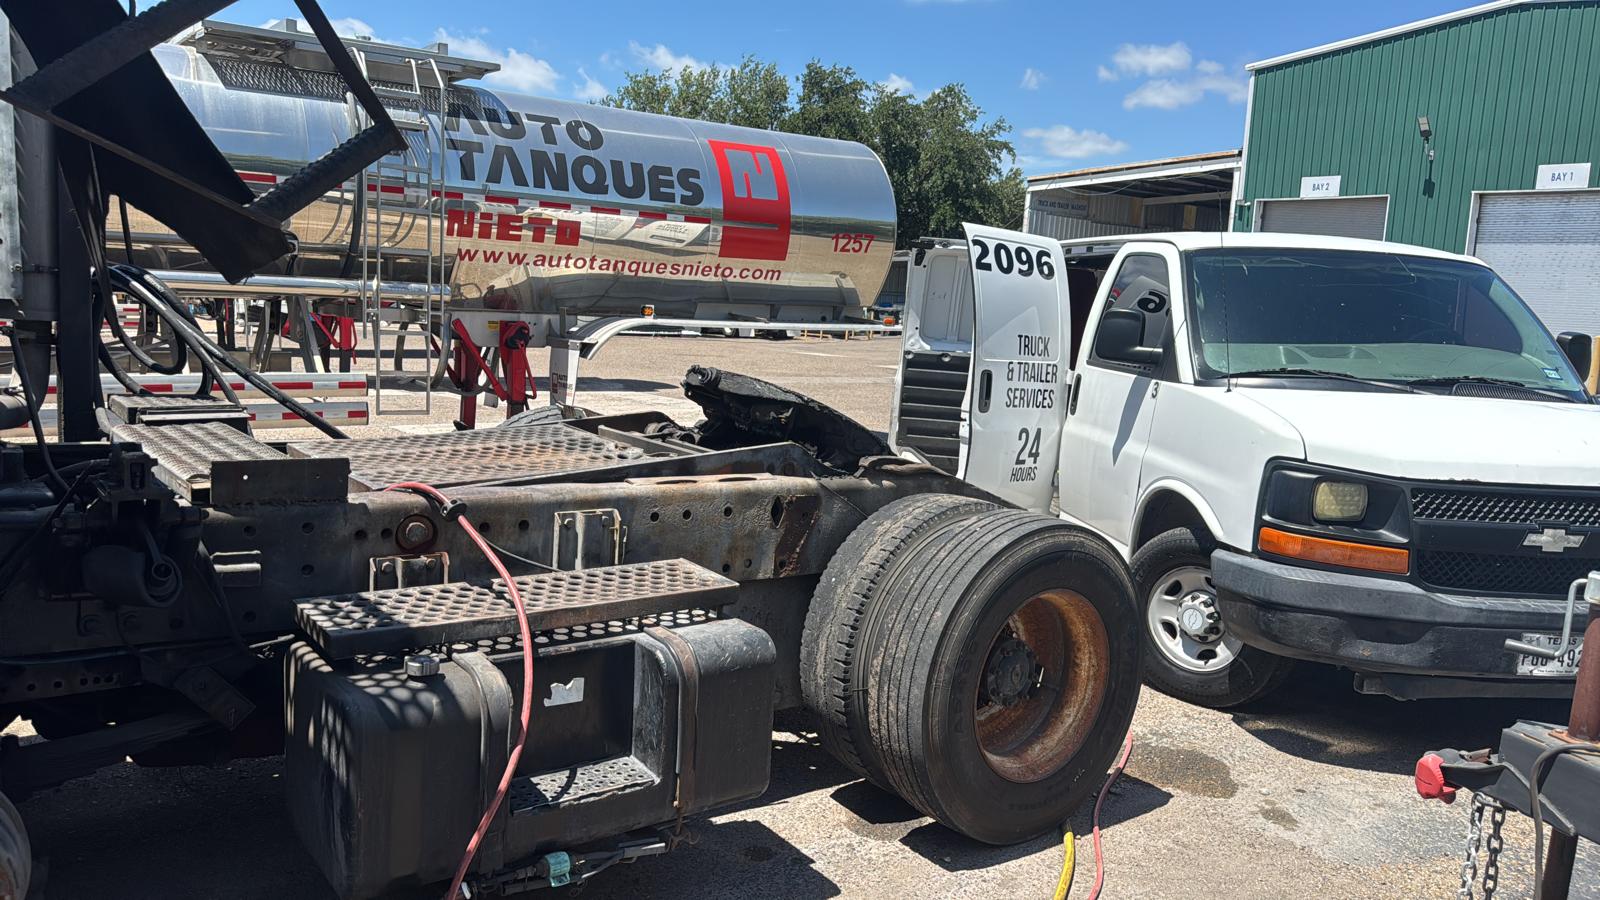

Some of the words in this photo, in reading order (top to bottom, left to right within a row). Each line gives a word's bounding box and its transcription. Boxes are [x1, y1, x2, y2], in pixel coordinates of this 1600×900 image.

[445, 102, 604, 150] AUTO
[446, 138, 705, 206] TANQUES
[1551, 172, 1567, 182] BAY
[1312, 183, 1325, 192] BAY
[1325, 182, 1330, 191] 2
[832, 233, 875, 253] 1257
[457, 247, 781, 281] www.autotanquesnieto.com
[971, 238, 1055, 280] 2096
[1017, 334, 1050, 357] TRUCK
[1006, 361, 1014, 382] &
[1017, 361, 1058, 383] TRAILER
[1005, 387, 1055, 409] SERVICES
[1015, 427, 1041, 465] 24
[1010, 466, 1038, 482] HOURS
